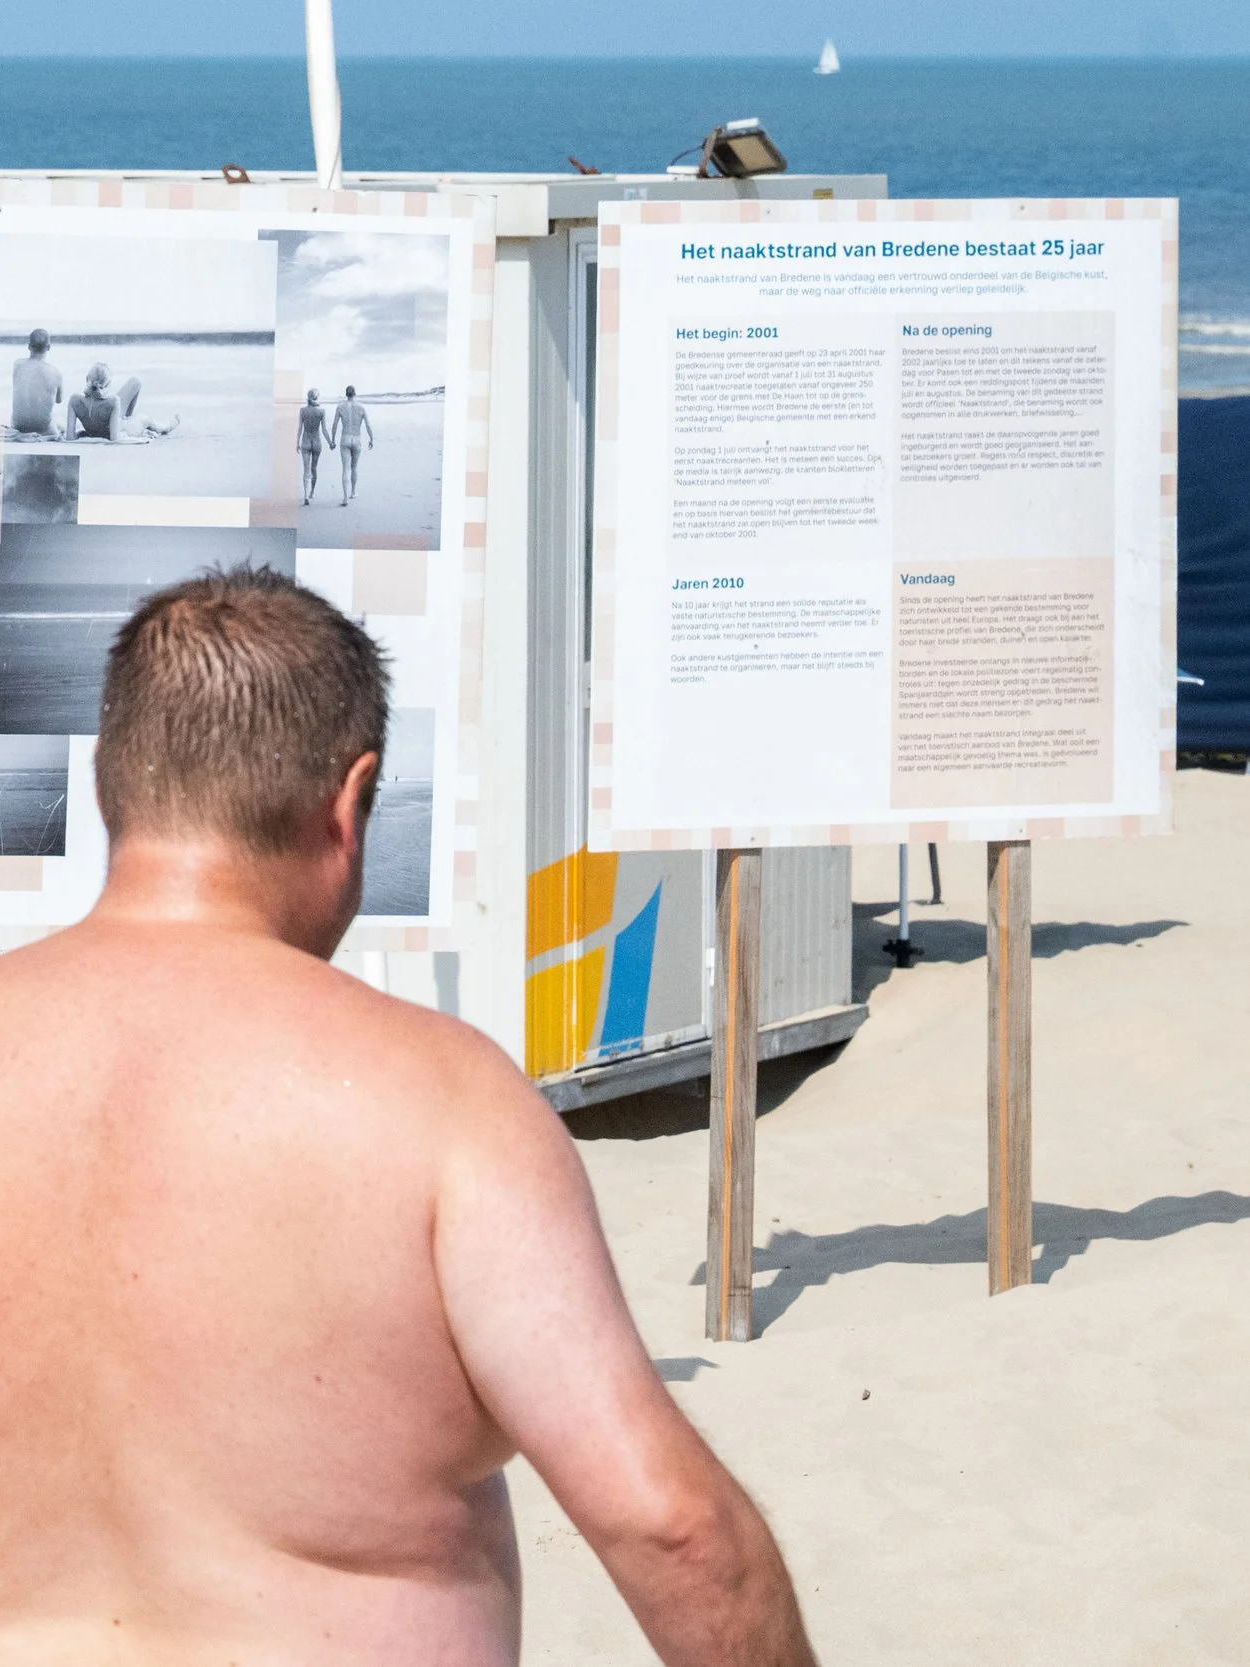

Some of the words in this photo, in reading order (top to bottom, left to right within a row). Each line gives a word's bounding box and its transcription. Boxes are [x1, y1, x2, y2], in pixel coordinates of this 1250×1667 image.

[681, 244, 716, 258] Het
[720, 243, 837, 258] naaktstrand
[842, 245, 875, 257] van
[880, 242, 960, 257] Bredene
[965, 242, 1036, 256] bestaat
[1041, 241, 1064, 256] 25
[1069, 241, 1105, 259] jaar
[676, 273, 694, 284] Het
[759, 275, 777, 283] van
[779, 272, 820, 283] Bredene
[823, 272, 831, 282] is
[834, 271, 875, 285] vandaag
[877, 274, 895, 282] een
[897, 271, 947, 282] vertrouwd
[949, 270, 998, 281] onderdeel
[1000, 273, 1018, 281] van
[1020, 270, 1032, 280] de
[1034, 269, 1082, 283] Belgische
[759, 288, 783, 296] maar
[785, 285, 798, 296] de
[800, 288, 821, 299] weg
[823, 288, 845, 296] naar
[847, 285, 887, 296] officiële
[889, 284, 938, 298] erkenning
[940, 284, 973, 298] verliep
[676, 327, 698, 339] Het
[702, 327, 742, 341] begin:
[746, 327, 779, 338] 2001
[902, 325, 919, 336] Na
[922, 325, 938, 336] de
[941, 324, 992, 338] opening
[672, 578, 708, 589] Jaren
[712, 577, 744, 588] 2010
[900, 573, 956, 587] Vandaag
